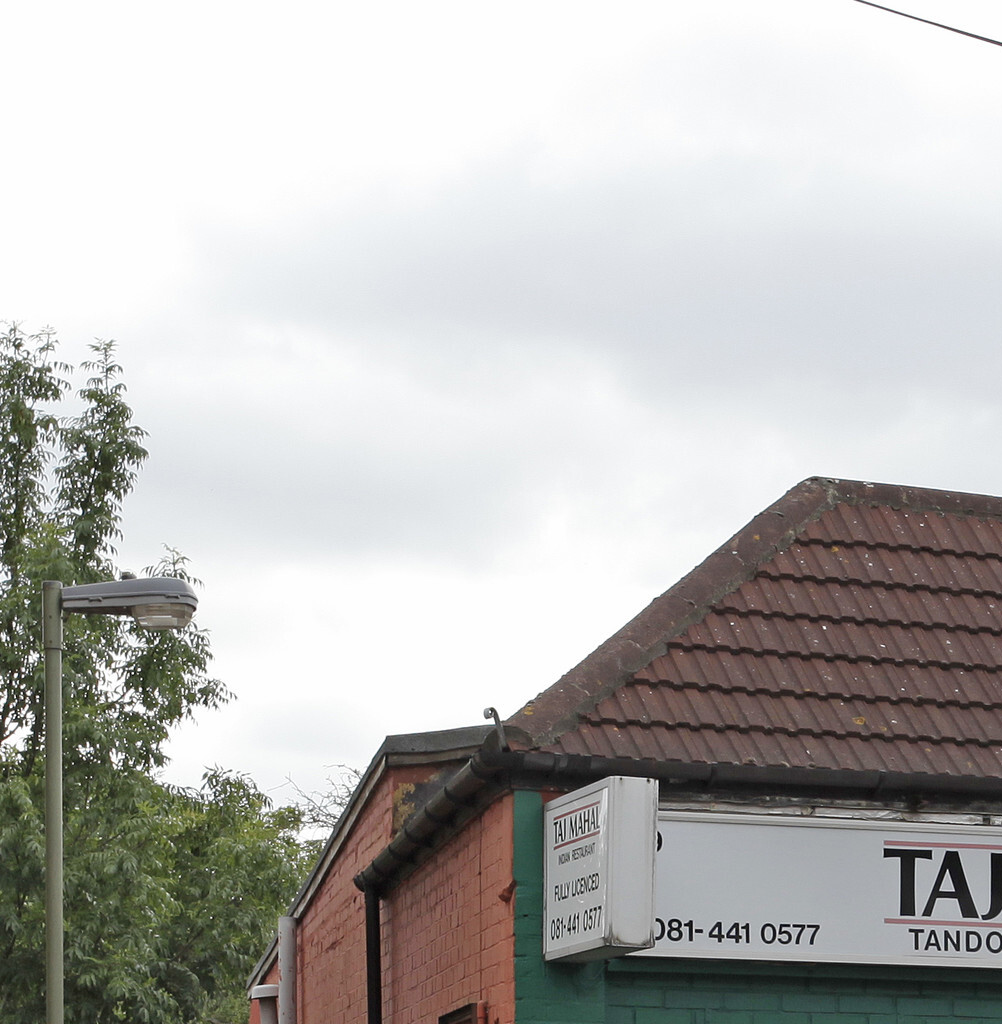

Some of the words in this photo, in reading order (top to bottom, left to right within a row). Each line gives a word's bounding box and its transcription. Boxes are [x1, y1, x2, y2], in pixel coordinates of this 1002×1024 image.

[553, 819, 567, 844] TAJ
[569, 805, 600, 839] MAHAL
[571, 842, 596, 863] RESTAURANT
[554, 882, 571, 902] FULLY
[571, 872, 600, 898] LICENCED
[550, 911, 580, 941] 081-441
[582, 905, 602, 932] 0577
[760, 922, 820, 946] 0577
